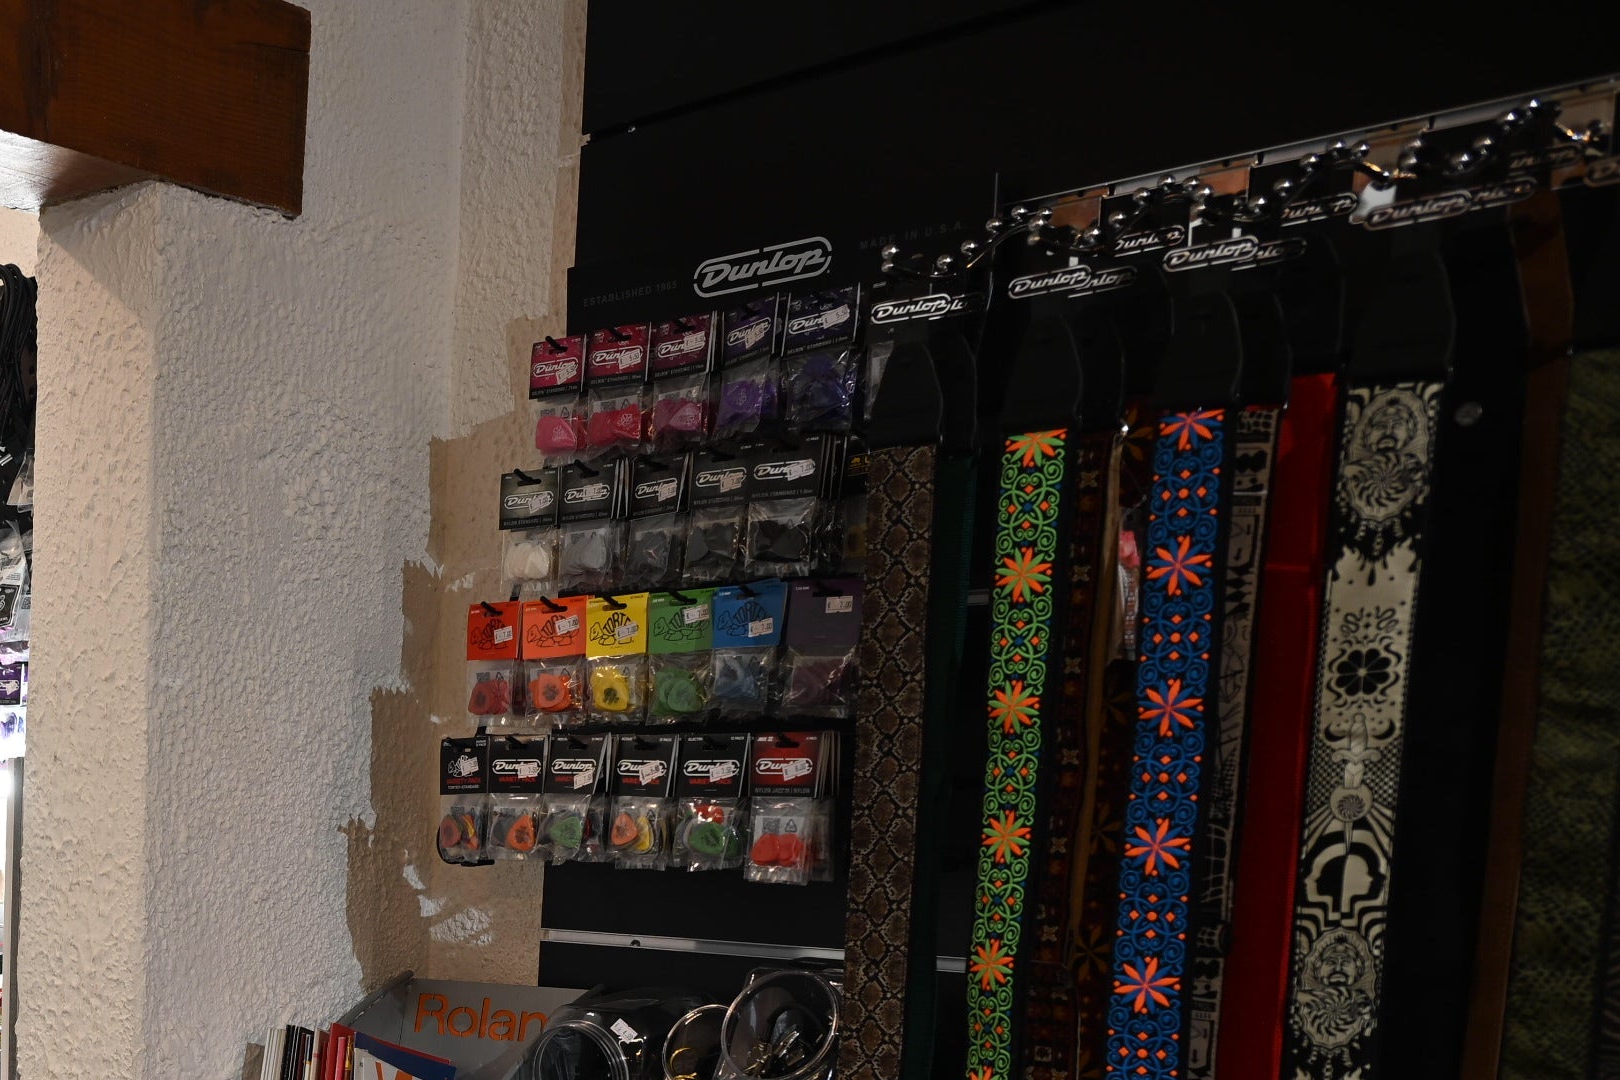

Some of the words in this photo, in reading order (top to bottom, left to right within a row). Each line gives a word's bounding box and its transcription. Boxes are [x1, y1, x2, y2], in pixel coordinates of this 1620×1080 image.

[1369, 199, 1467, 223] Dunlop
[860, 234, 897, 250] MADE
[905, 229, 918, 241] IN
[1169, 242, 1253, 266] Dunlop
[701, 247, 827, 289] Dunlop
[1012, 271, 1089, 293] Dunlop
[583, 284, 652, 307] ESTABLISHED
[656, 280, 678, 294] 1965
[874, 299, 950, 320] Dunlop
[568, 618, 579, 626] 7.00
[697, 608, 709, 617] 7.00
[761, 623, 772, 631] 7.00
[553, 761, 593, 771] Dunlop
[413, 992, 550, 1042] Rolan
